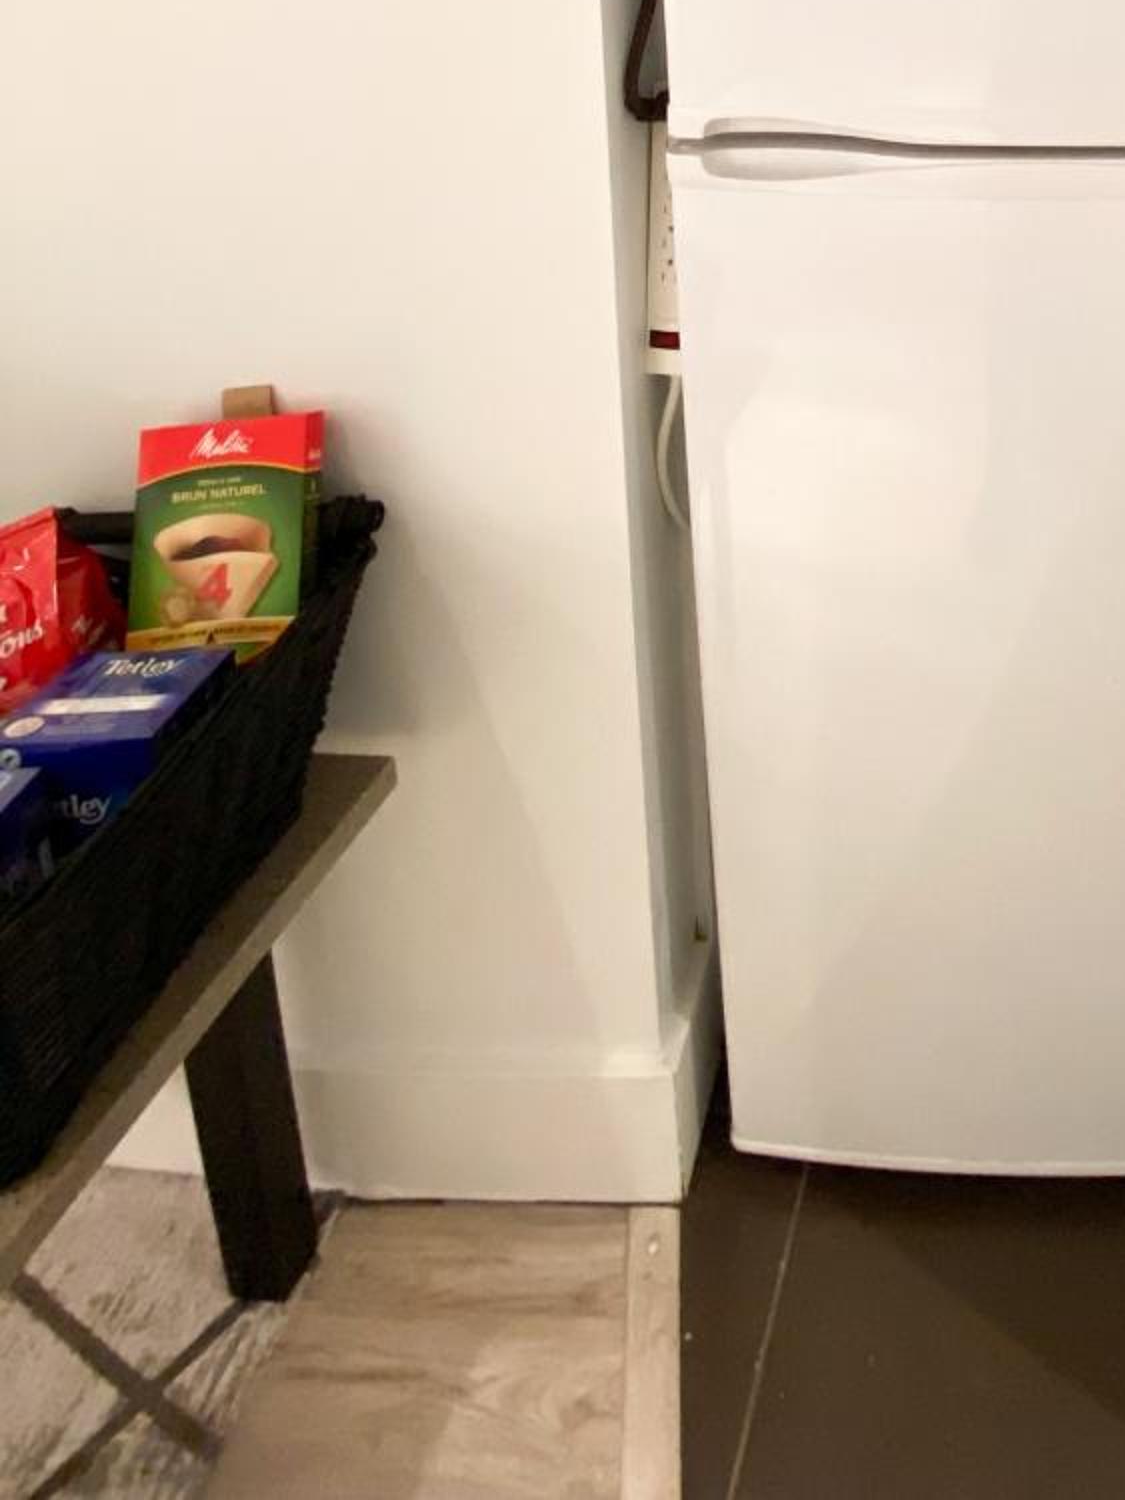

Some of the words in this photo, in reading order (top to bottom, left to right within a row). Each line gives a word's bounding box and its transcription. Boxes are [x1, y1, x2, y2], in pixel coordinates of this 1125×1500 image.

[171, 489, 207, 503] BRUN
[210, 484, 268, 500] NATUREL
[197, 563, 233, 611] 4
[104, 657, 185, 678] Tetley
